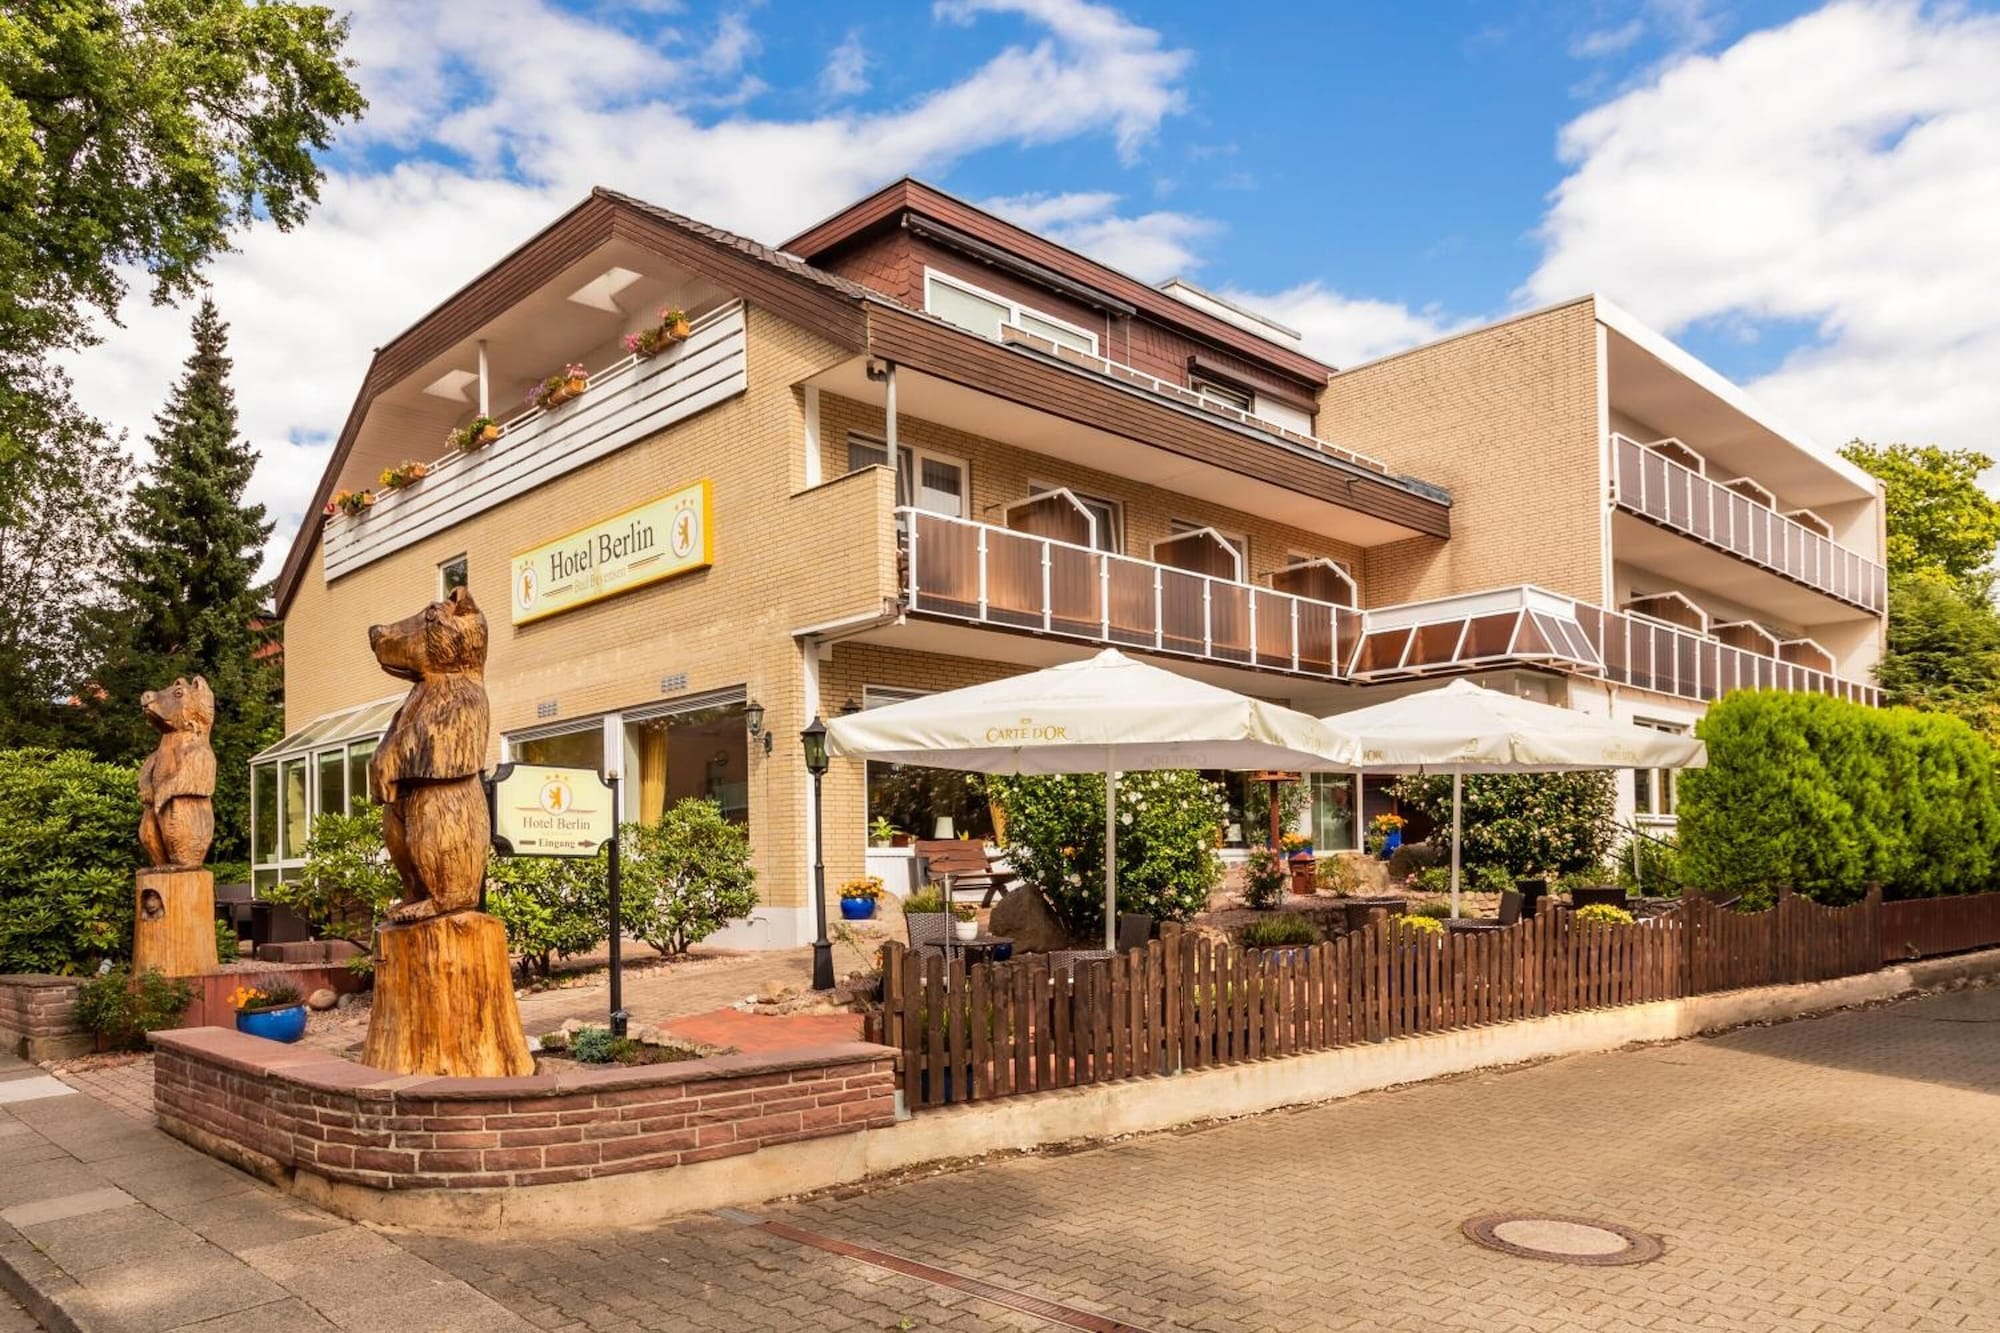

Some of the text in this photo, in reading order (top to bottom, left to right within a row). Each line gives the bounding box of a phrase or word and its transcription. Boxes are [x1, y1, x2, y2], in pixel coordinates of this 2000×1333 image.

[550, 519, 655, 582] Hotel Berlin
[986, 726, 1028, 743] CARTE
[523, 816, 591, 831] Hotel Berlin
[539, 838, 576, 849] Eingang
